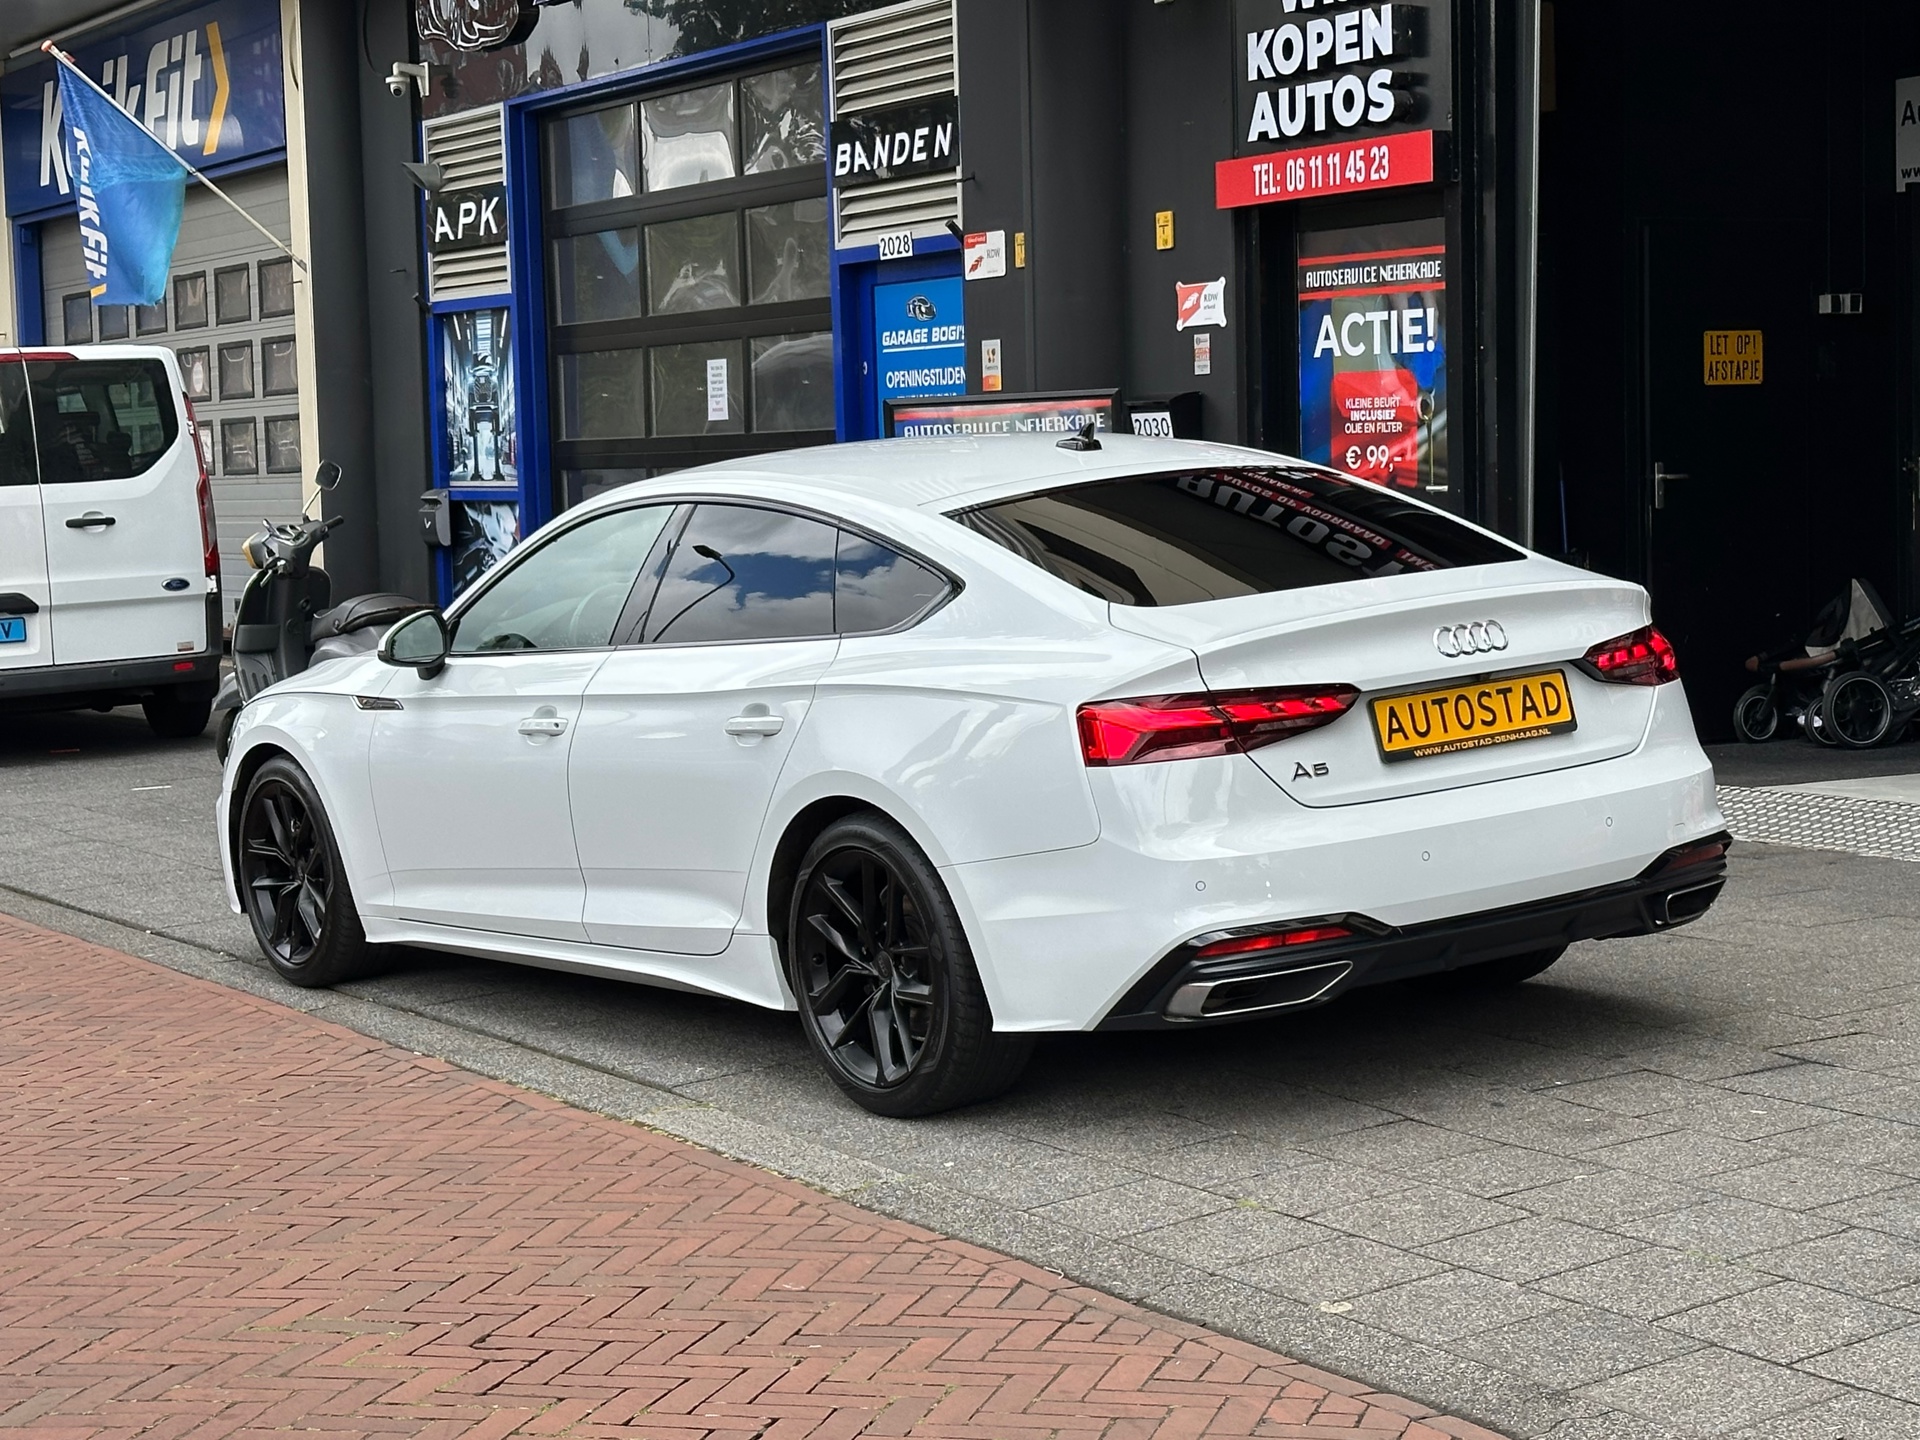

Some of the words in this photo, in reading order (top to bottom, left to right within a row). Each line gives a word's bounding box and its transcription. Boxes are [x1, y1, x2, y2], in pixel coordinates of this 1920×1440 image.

[1247, 3, 1393, 81] KOPEN
[1247, 68, 1395, 142] AUTOS
[835, 122, 952, 176] BANDEN
[1253, 162, 1281, 196] TEL:
[1286, 157, 1305, 192] 06
[1309, 155, 1322, 188] 11
[1327, 152, 1340, 186] 11
[1345, 149, 1365, 183] 45
[1370, 145, 1389, 181] 23
[434, 197, 499, 243] APK
[880, 234, 911, 256] 2028
[1305, 266, 1378, 288] AUTOSERVICE
[1380, 260, 1442, 282] NEHERKADE
[882, 328, 929, 347] GARAGE
[1313, 307, 1435, 359] ACTIE!
[1710, 334, 1729, 355] LET
[1736, 334, 1757, 355] OP!
[1708, 360, 1760, 381] AFSTAPJE
[1345, 397, 1373, 409] KLEINE
[1374, 395, 1401, 409] BEURT
[1134, 417, 1170, 437] 2030
[1344, 422, 1363, 434] OLIE
[1364, 422, 1375, 433] EN
[1376, 421, 1403, 433] FILTER
[1350, 409, 1397, 421] INCLUSIEF
[1387, 681, 1562, 744] AUTOSTAD
[1413, 728, 1552, 758] WWW.AUTOSTAD-DENHAAG.NL
[1291, 761, 1330, 782] A5
